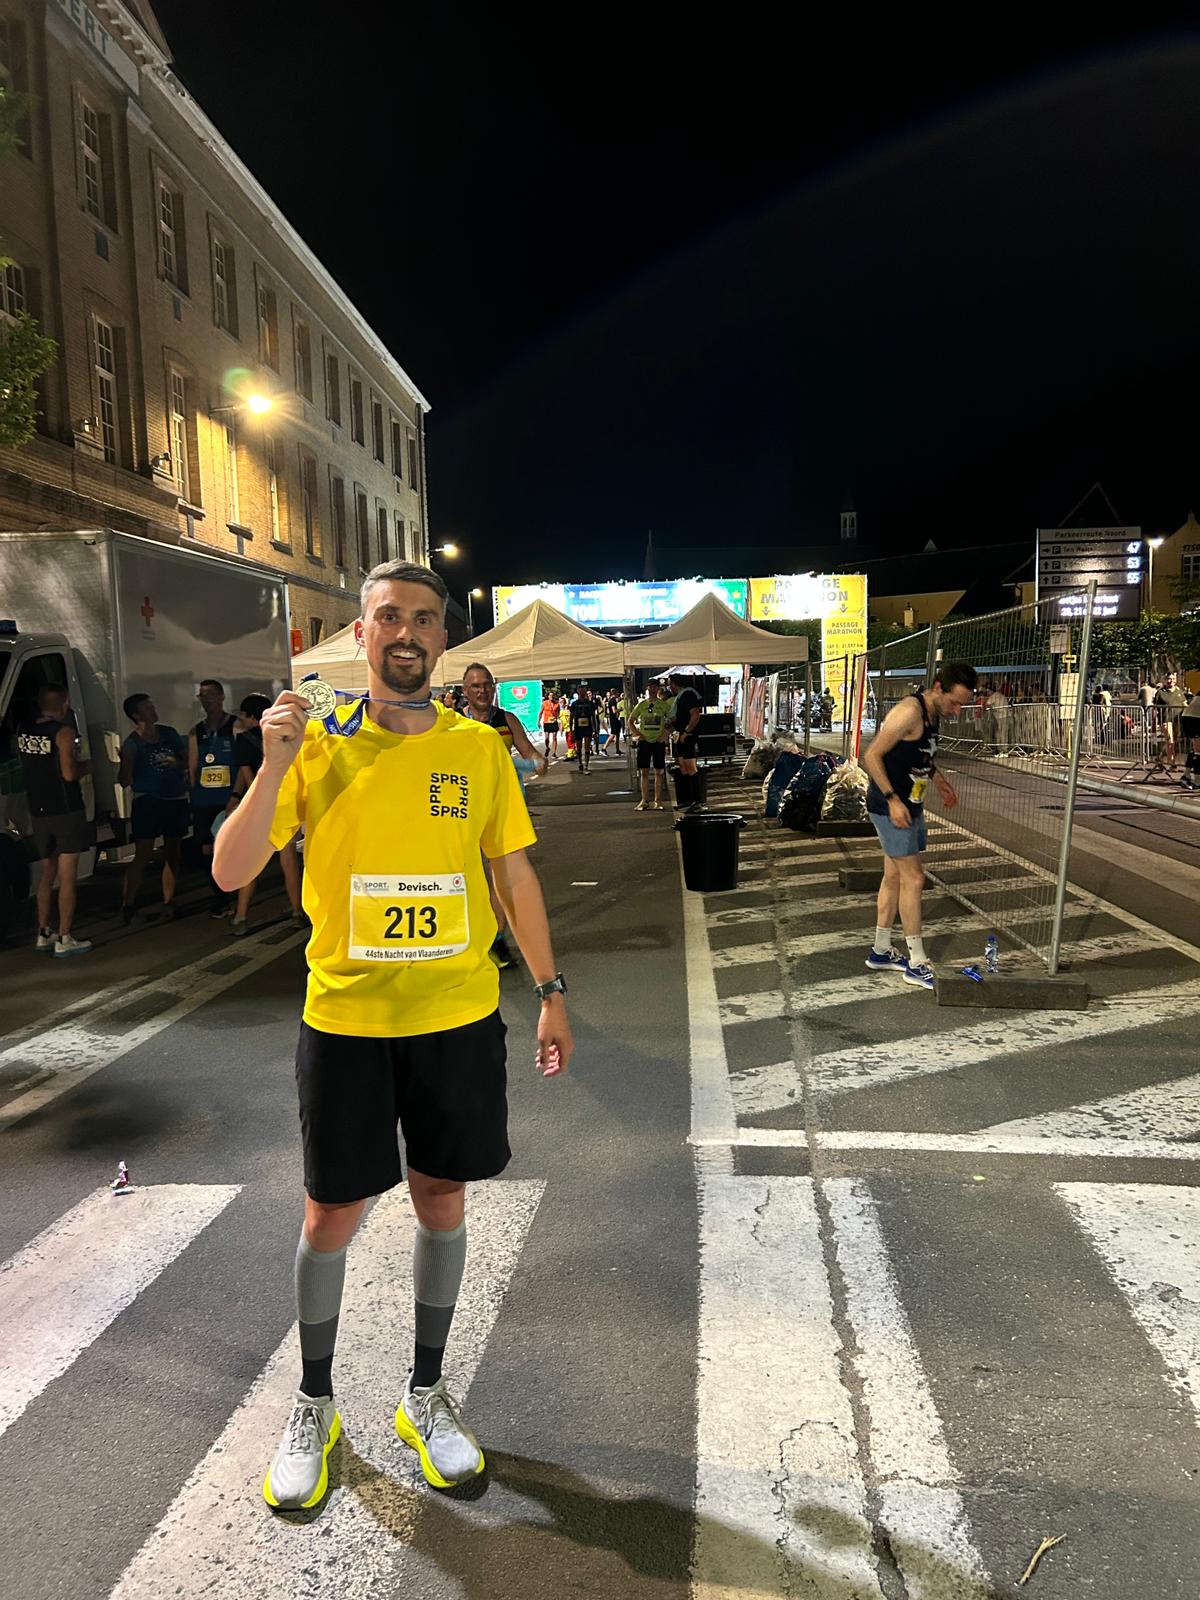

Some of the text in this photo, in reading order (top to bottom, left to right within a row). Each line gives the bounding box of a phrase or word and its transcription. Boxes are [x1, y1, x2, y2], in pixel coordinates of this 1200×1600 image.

[59, 0, 108, 54] ERT
[1054, 530, 1102, 538] Parkeerroute
[206, 773, 222, 782] 329
[430, 772, 468, 786] SPRS
[430, 806, 468, 819] SPRS
[398, 882, 442, 891] Devisch.
[384, 906, 437, 938] 213
[365, 950, 384, 958] 44ste
[385, 950, 404, 959] Nacht
[418, 948, 454, 958] Vlaanderen
